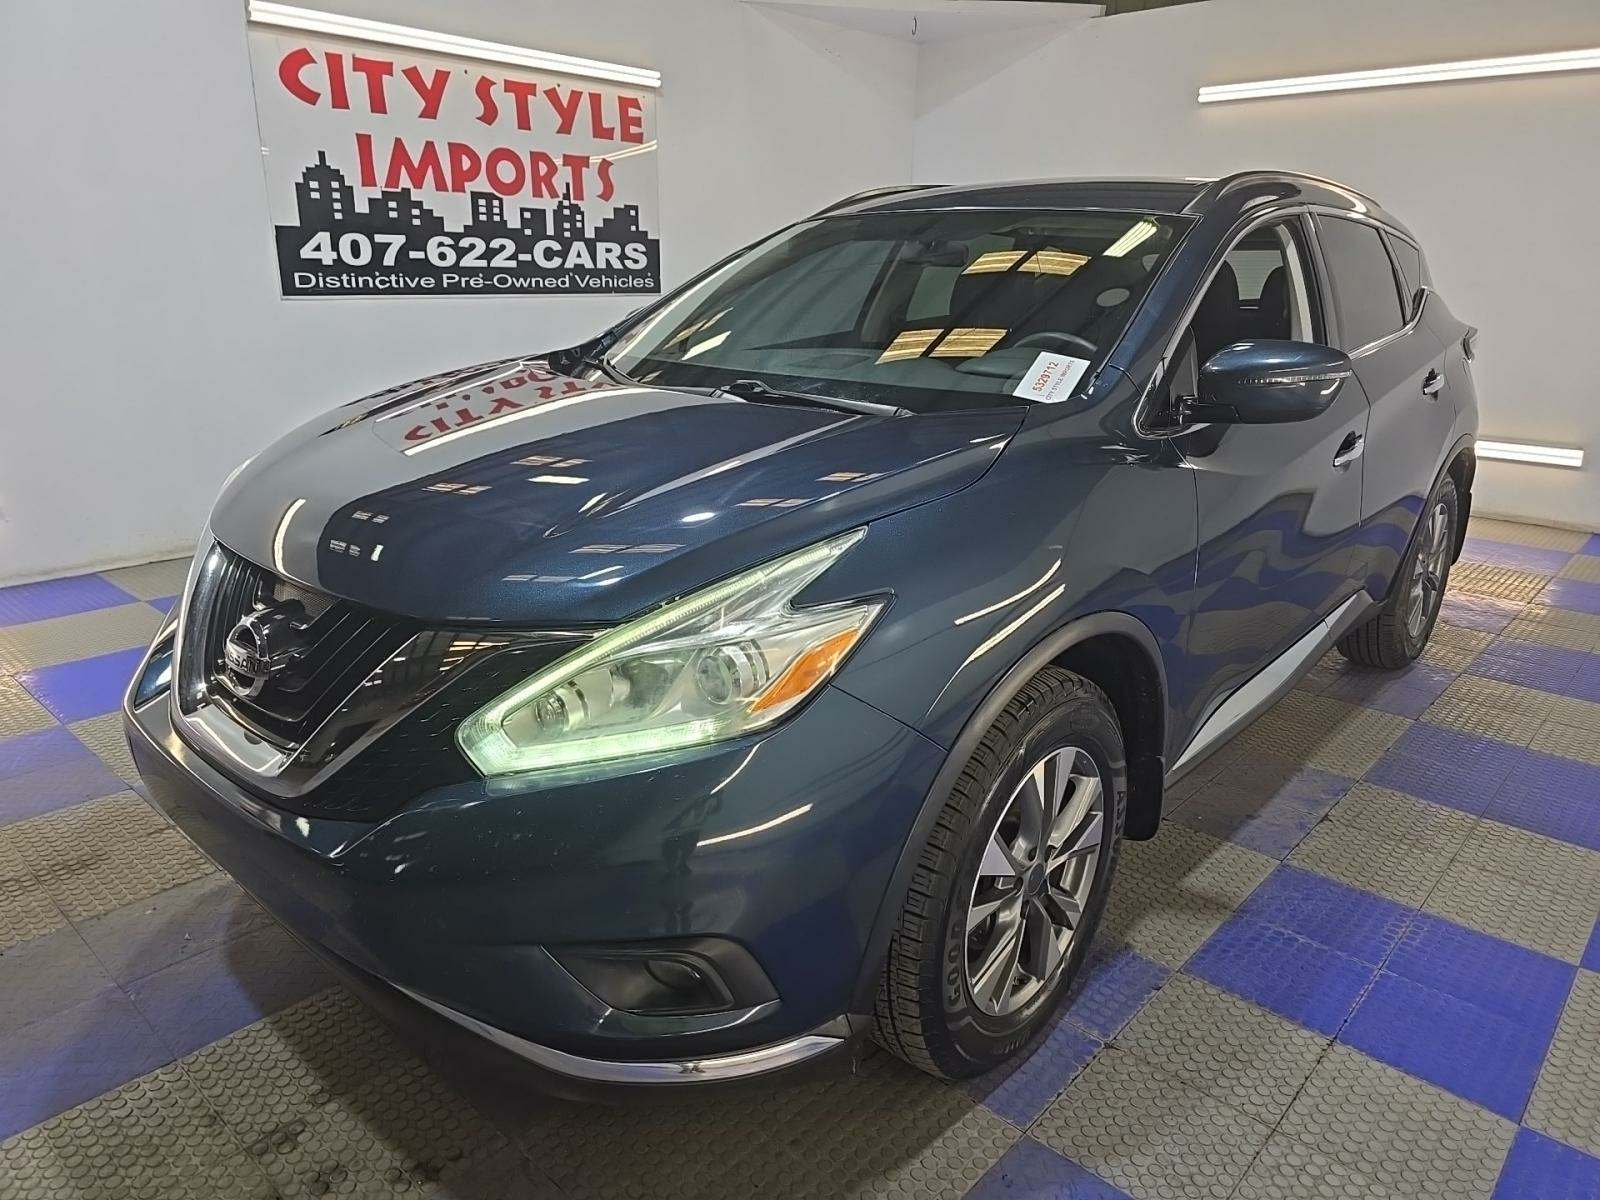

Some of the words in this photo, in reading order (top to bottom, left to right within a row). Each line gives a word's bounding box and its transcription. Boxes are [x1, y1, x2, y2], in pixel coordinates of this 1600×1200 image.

[279, 47, 451, 120] CITY
[475, 75, 644, 144] STYLE
[355, 132, 615, 202] IMPORTS
[300, 231, 648, 270] 407-622-CARS
[293, 271, 436, 290] Distinctive
[442, 272, 571, 289] Pre-Owned
[574, 273, 655, 289] Vehicles
[1032, 361, 1060, 392] 5329712
[1051, 377, 1064, 392] STYLE
